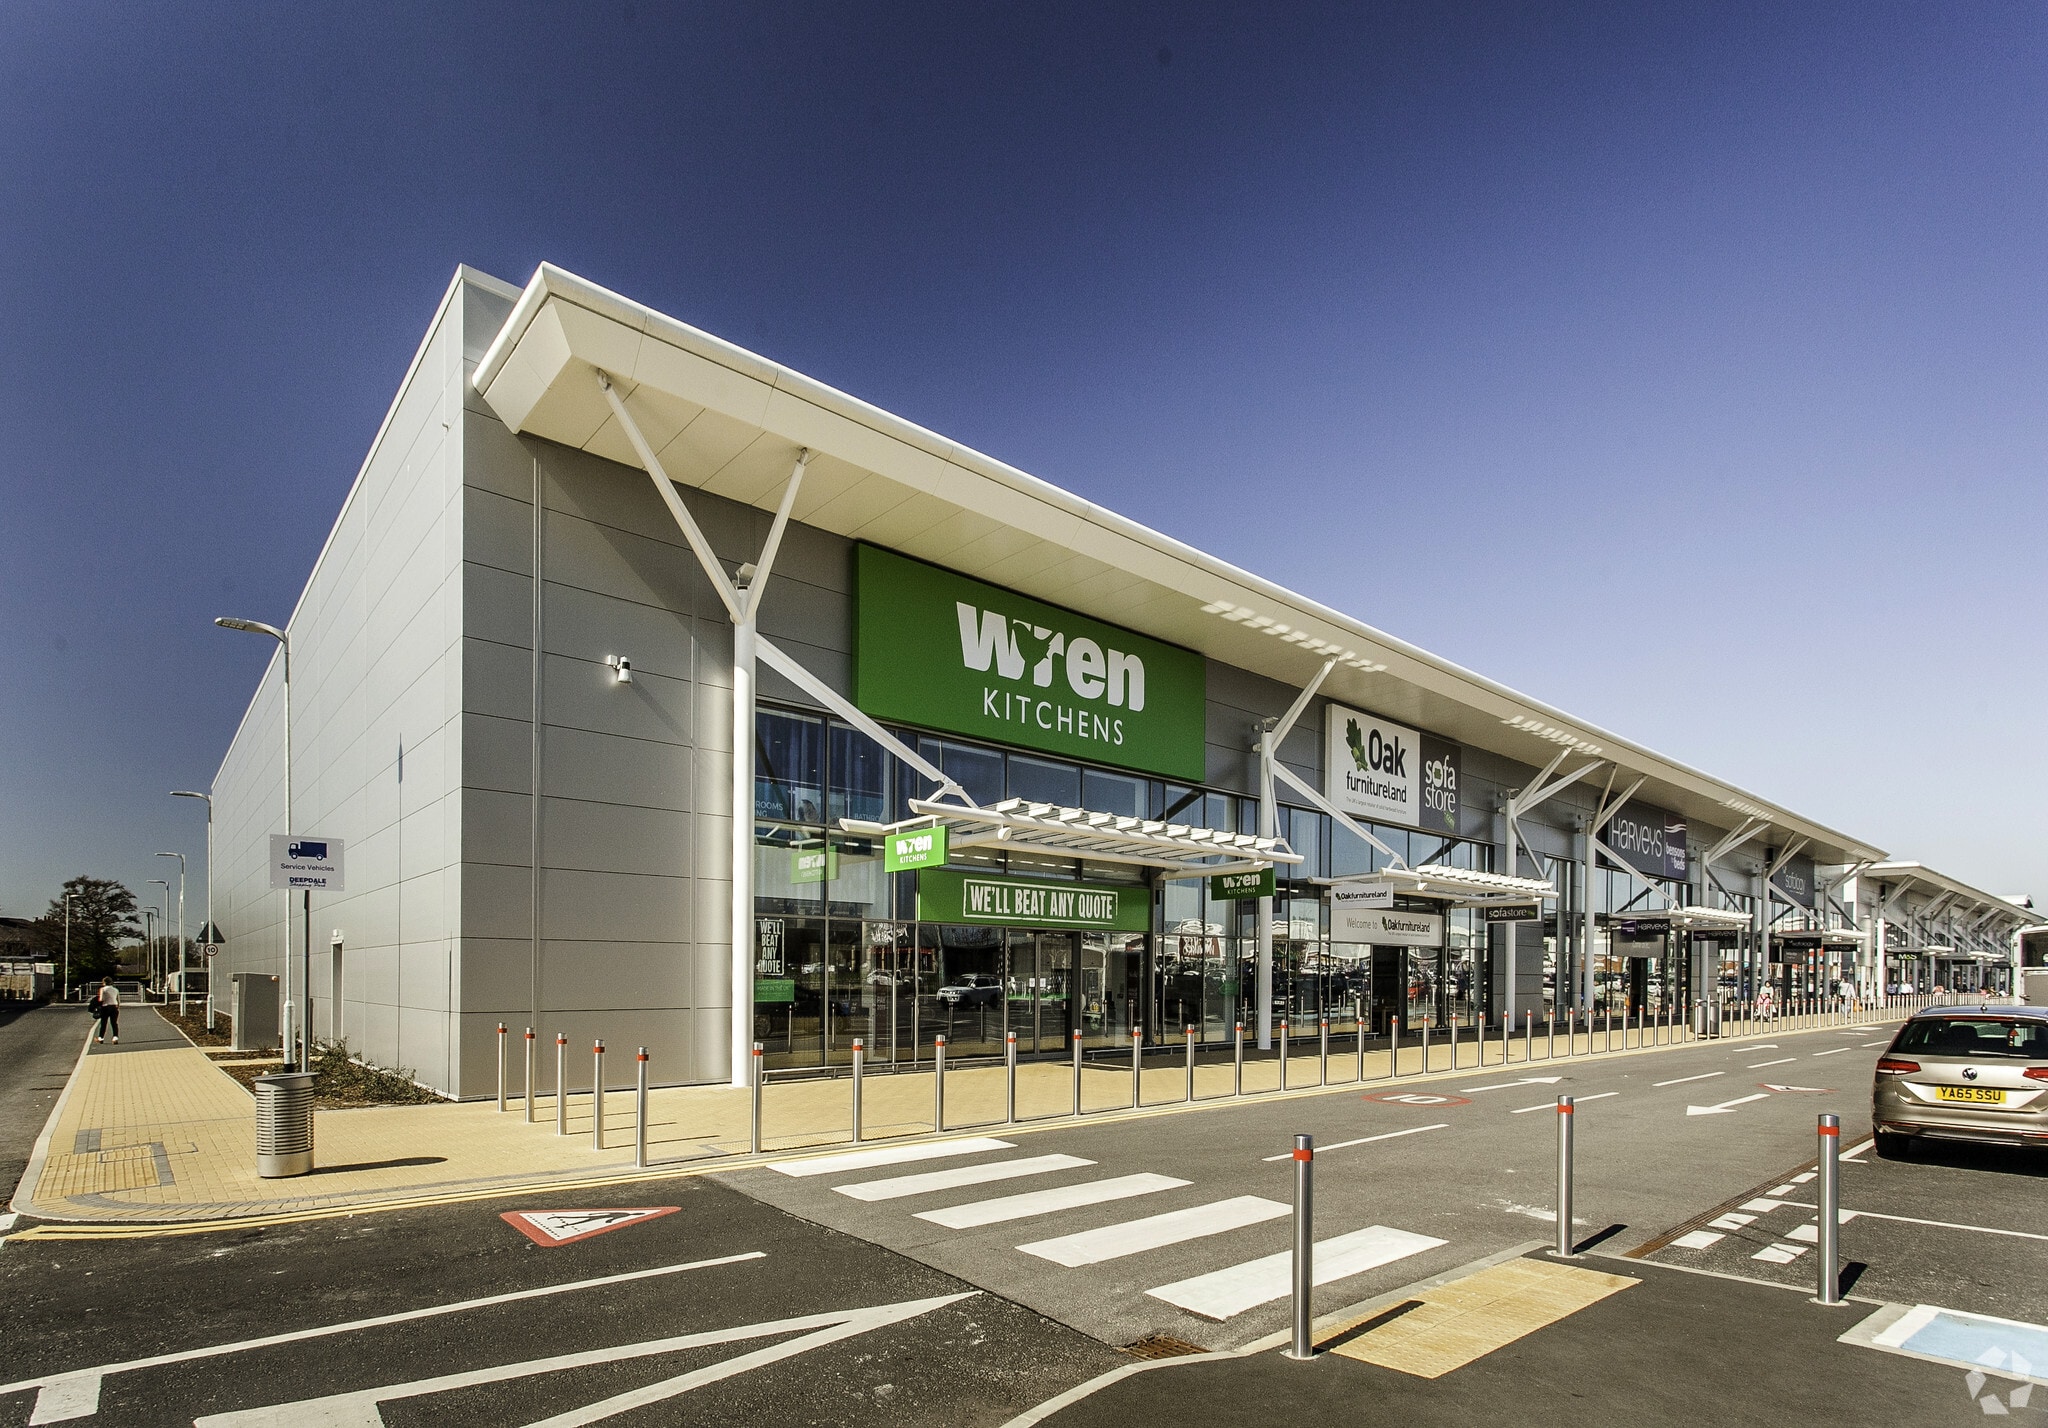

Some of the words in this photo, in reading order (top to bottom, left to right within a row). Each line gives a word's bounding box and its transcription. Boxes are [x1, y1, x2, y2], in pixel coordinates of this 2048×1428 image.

[956, 601, 1145, 712] wren
[983, 687, 1123, 746] KITCHENS
[1368, 728, 1407, 779] Oak
[1425, 755, 1456, 790] sofa
[1346, 770, 1407, 804] furnitureland
[1425, 783, 1456, 813] store
[755, 800, 784, 811] ROOMS
[854, 813, 881, 822] BATHRO
[896, 835, 932, 855] wren
[900, 853, 927, 863] KITCHENS
[280, 862, 306, 870] Service
[307, 864, 335, 872] Vehicles
[289, 876, 327, 884] DEEPDALE
[1223, 874, 1260, 888] wren
[970, 885, 1010, 914] WE'LL
[1015, 888, 1046, 916] BEAT
[1050, 891, 1074, 918] ANY
[1078, 893, 1113, 919] QUOTE
[760, 920, 781, 935] WE'LL
[1346, 917, 1371, 930] Welcome
[1372, 921, 1378, 930] to
[761, 934, 779, 947] BEAT
[762, 947, 777, 960] ANY
[758, 960, 781, 973] QUOTE
[1940, 1087, 1973, 1099] YA65
[1976, 1089, 2001, 1101] SSU
